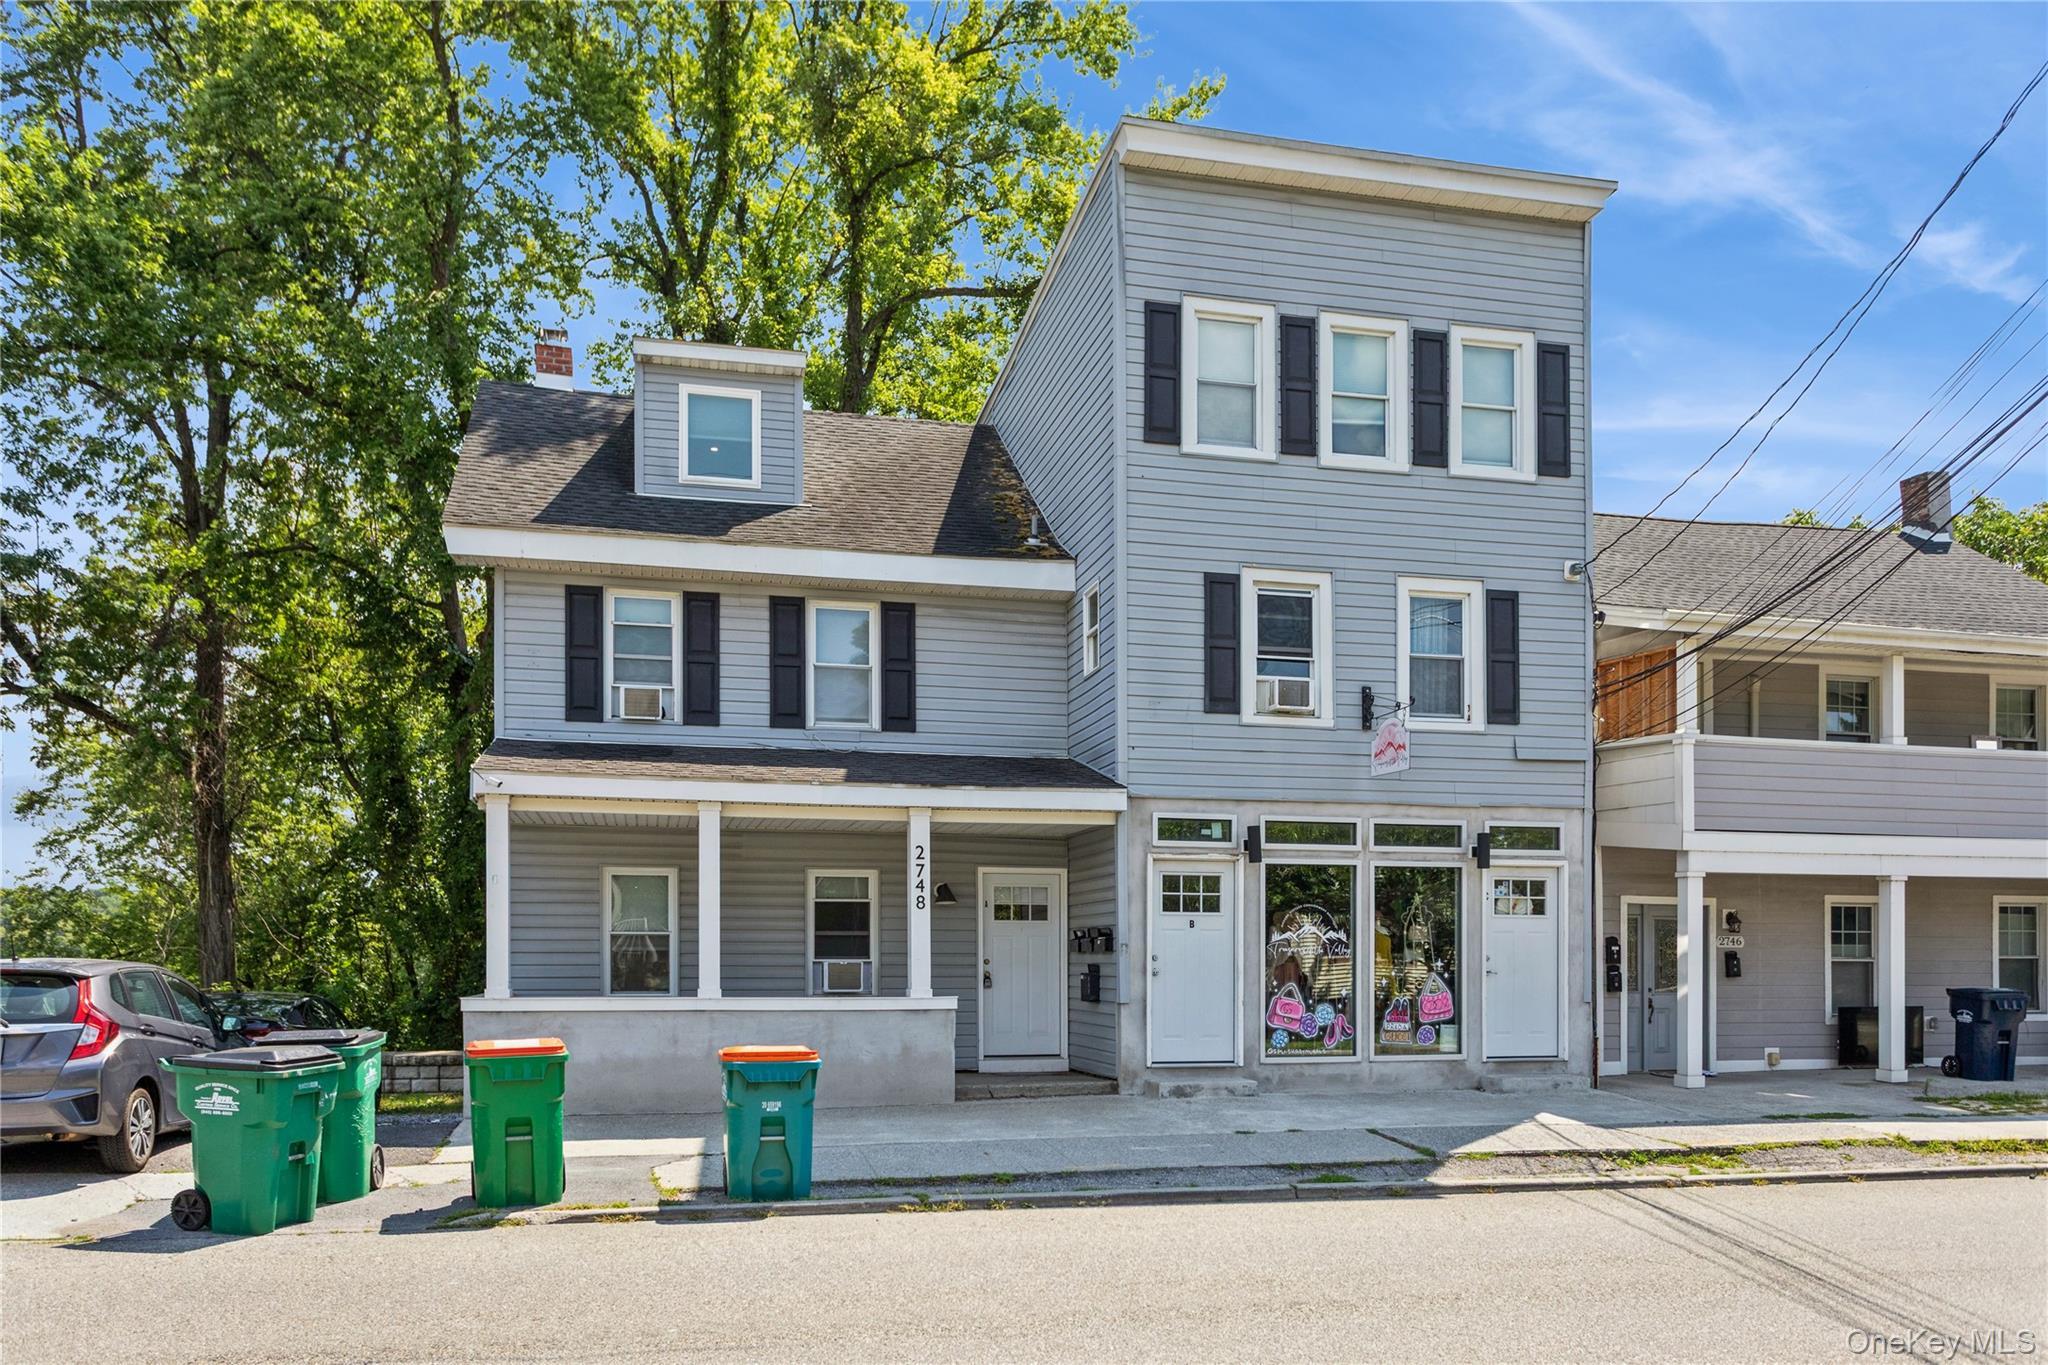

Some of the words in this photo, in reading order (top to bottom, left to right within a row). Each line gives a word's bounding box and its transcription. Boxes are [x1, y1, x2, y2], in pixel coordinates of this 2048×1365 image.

[915, 844, 926, 910] 2748
[1189, 920, 1195, 928] B
[1718, 937, 1742, 946] 2746
